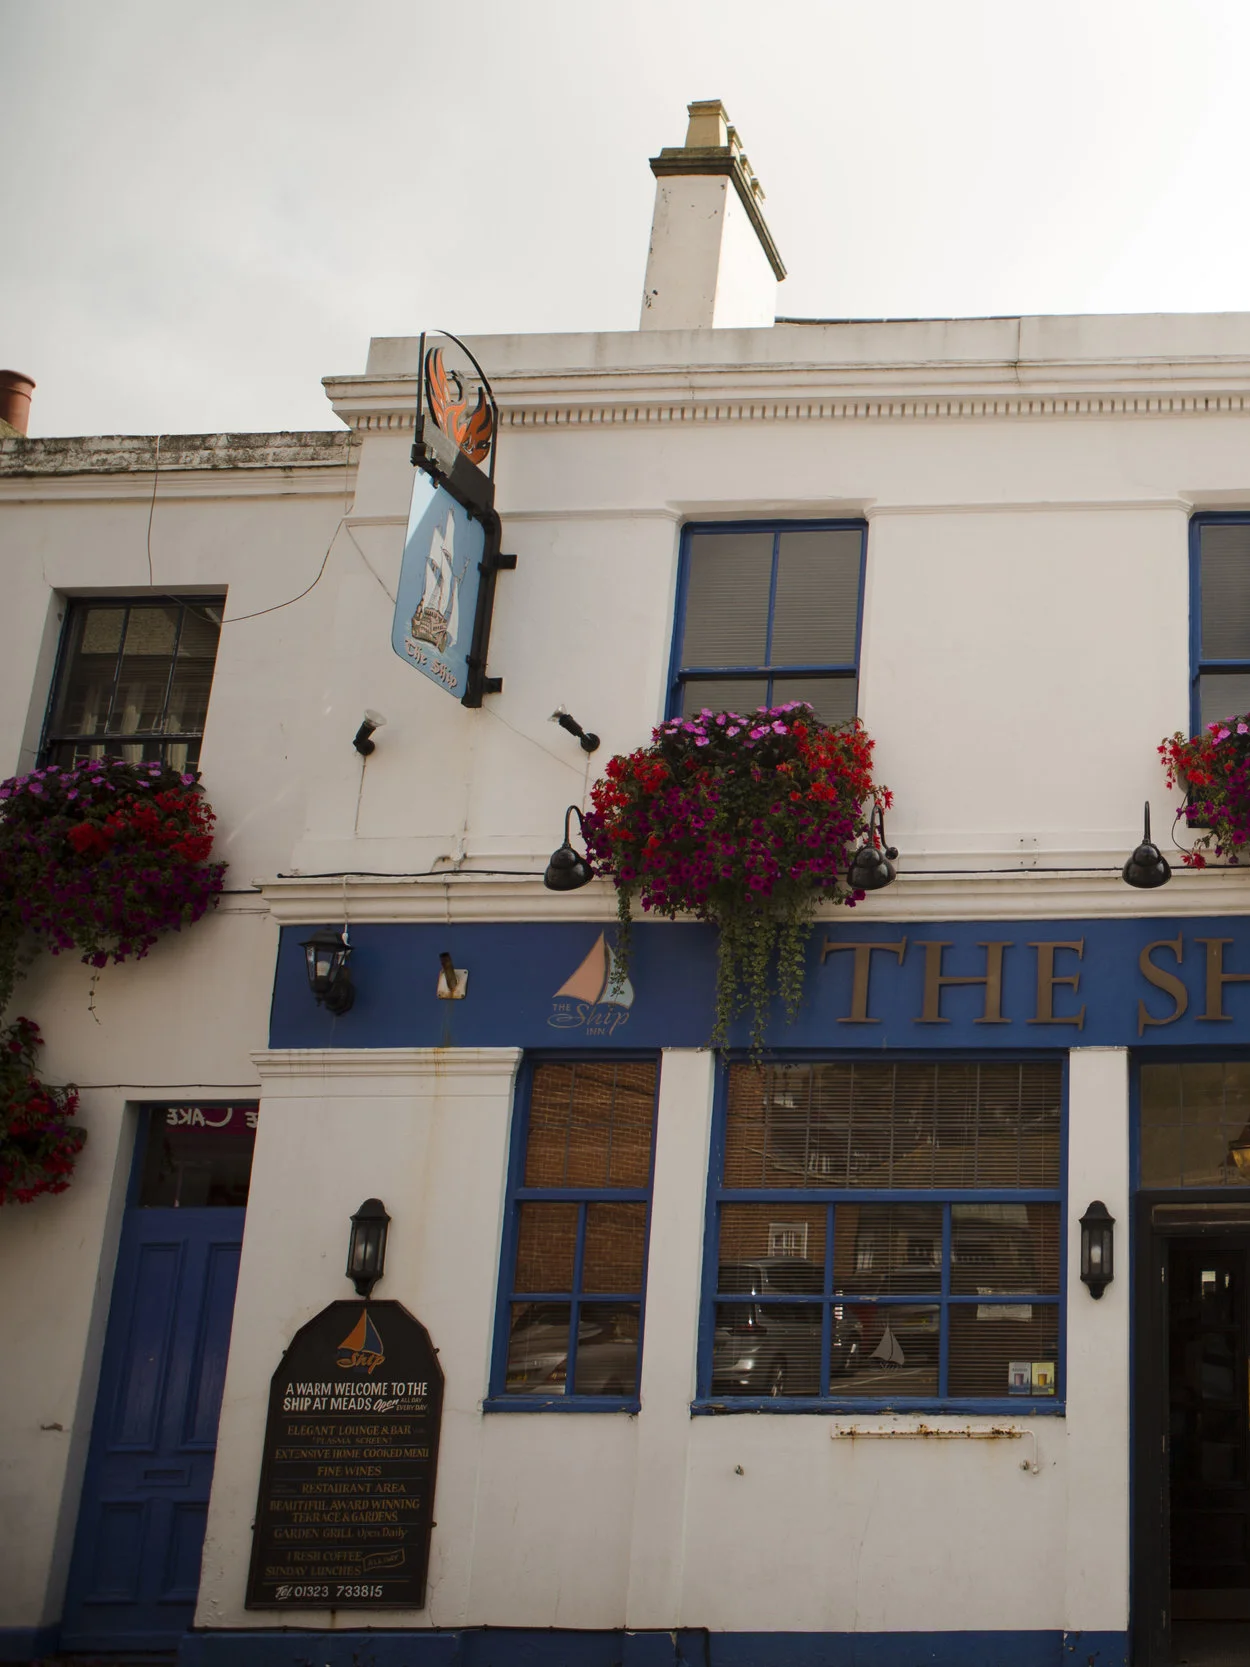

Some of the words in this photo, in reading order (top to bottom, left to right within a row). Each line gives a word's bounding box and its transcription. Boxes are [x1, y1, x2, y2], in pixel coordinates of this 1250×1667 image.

[405, 640, 427, 666] The
[430, 658, 458, 689] Ship
[820, 934, 1087, 1031] THE
[547, 1004, 629, 1036] Ship
[586, 1028, 604, 1036] INN
[336, 1352, 385, 1374] Ship
[285, 1382, 294, 1396] A
[296, 1382, 332, 1395] WARM
[334, 1382, 388, 1396] WELCOME
[391, 1382, 406, 1396] TO
[407, 1382, 428, 1396] THE
[283, 1398, 312, 1411] SHIP
[312, 1398, 328, 1410] AT
[330, 1398, 371, 1410] MEADS
[373, 1398, 399, 1412] Open
[287, 1425, 336, 1436] ELEGANT
[339, 1424, 380, 1435] LOUNGE
[380, 1425, 390, 1434] &
[390, 1424, 412, 1435] BAR
[275, 1448, 331, 1459] EXTENSIVE
[332, 1448, 360, 1458] HOME
[363, 1448, 402, 1458] COOKED
[403, 1448, 429, 1458] MENU
[317, 1466, 344, 1476] FINE
[345, 1466, 382, 1476] WINES
[301, 1483, 373, 1493] RESTAURANT
[374, 1483, 406, 1493] AREA
[270, 1500, 328, 1511] BEAUTIFUL
[330, 1499, 370, 1510] AWARD
[370, 1498, 420, 1509] WINNING
[292, 1512, 340, 1522] TERRACE
[342, 1512, 350, 1522] &
[351, 1511, 398, 1522] GARDENS
[274, 1528, 318, 1539] GARDEN
[322, 1528, 354, 1538] GRILL
[358, 1528, 380, 1540] Open
[382, 1526, 408, 1539] Daily
[287, 1552, 322, 1562] FRESH
[323, 1551, 363, 1561] COFFEE
[265, 1566, 308, 1577] SUNDAY
[310, 1566, 361, 1576] LUNCHES
[294, 1585, 328, 1597] 01323
[336, 1585, 384, 1598] 733815
